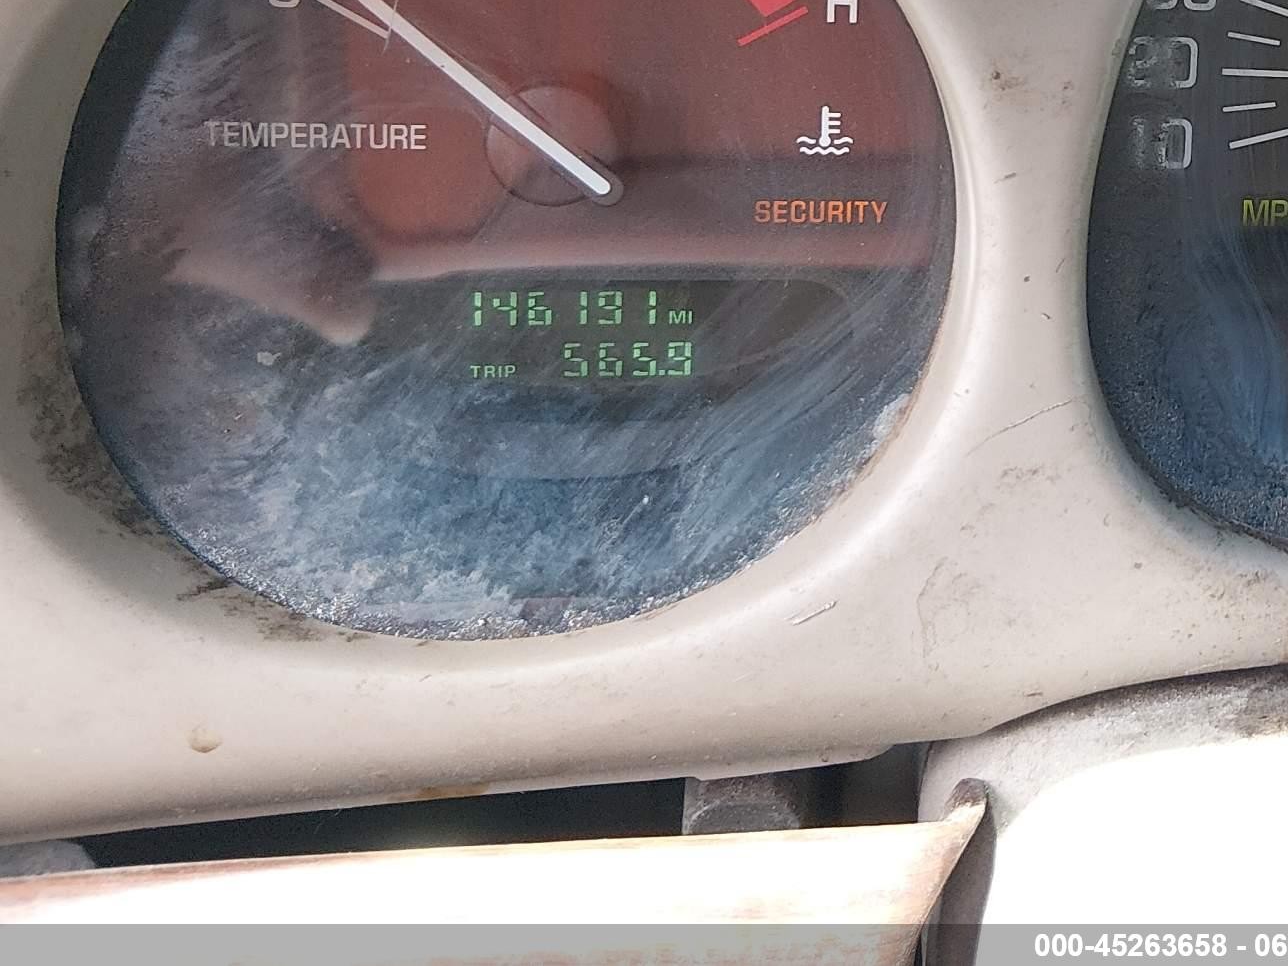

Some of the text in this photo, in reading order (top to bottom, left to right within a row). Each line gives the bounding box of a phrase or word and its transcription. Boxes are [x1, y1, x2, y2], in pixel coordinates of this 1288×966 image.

[204, 120, 428, 150] TEMPERATURE
[754, 200, 888, 224] SECURITY
[668, 310, 693, 325] MI
[470, 341, 692, 379] TRIP 565.9
